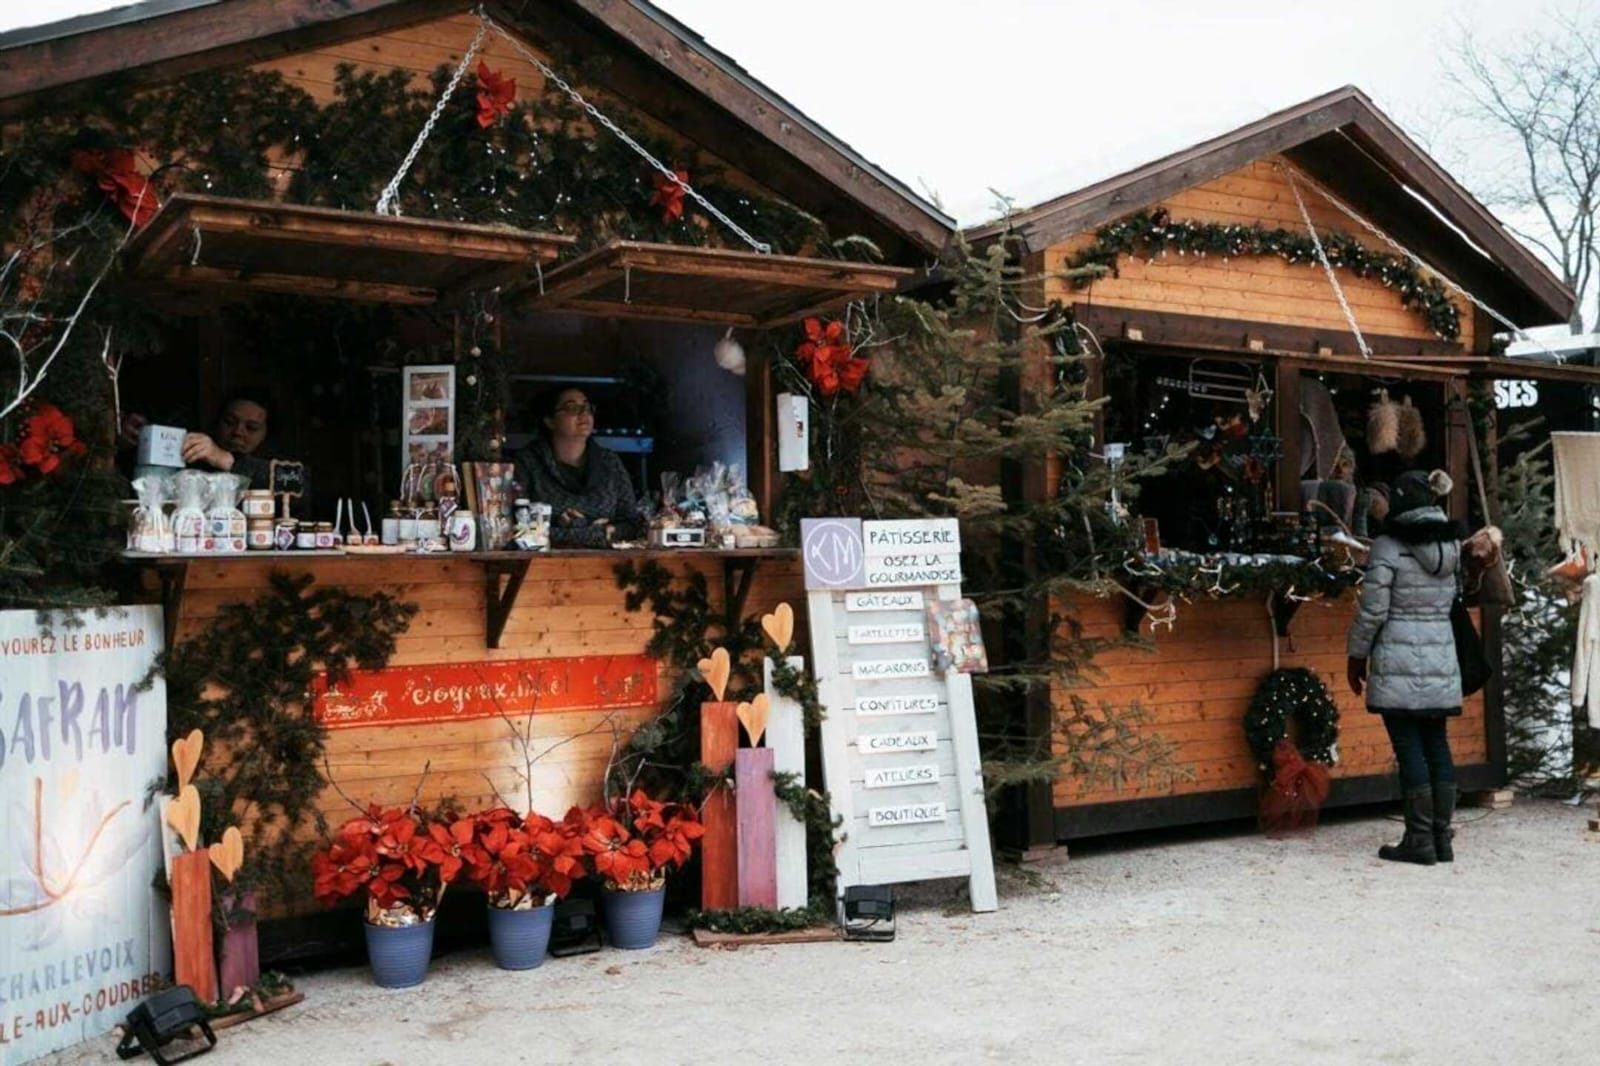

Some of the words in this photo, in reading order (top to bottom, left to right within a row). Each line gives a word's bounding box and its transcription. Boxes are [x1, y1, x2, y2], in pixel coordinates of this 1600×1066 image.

[883, 554, 919, 567] OSEZ
[924, 553, 942, 566] LA
[869, 568, 959, 584] GOURMANDISE
[63, 633, 79, 652] LE
[84, 628, 145, 651] BONHEUR
[859, 661, 926, 675] MACARONS
[859, 698, 937, 712] CONFITURES
[0, 679, 139, 769] AFRAN
[869, 735, 929, 749] CADEAUX
[874, 768, 933, 783] ATELIERS
[875, 805, 940, 822] BOUTIQUE
